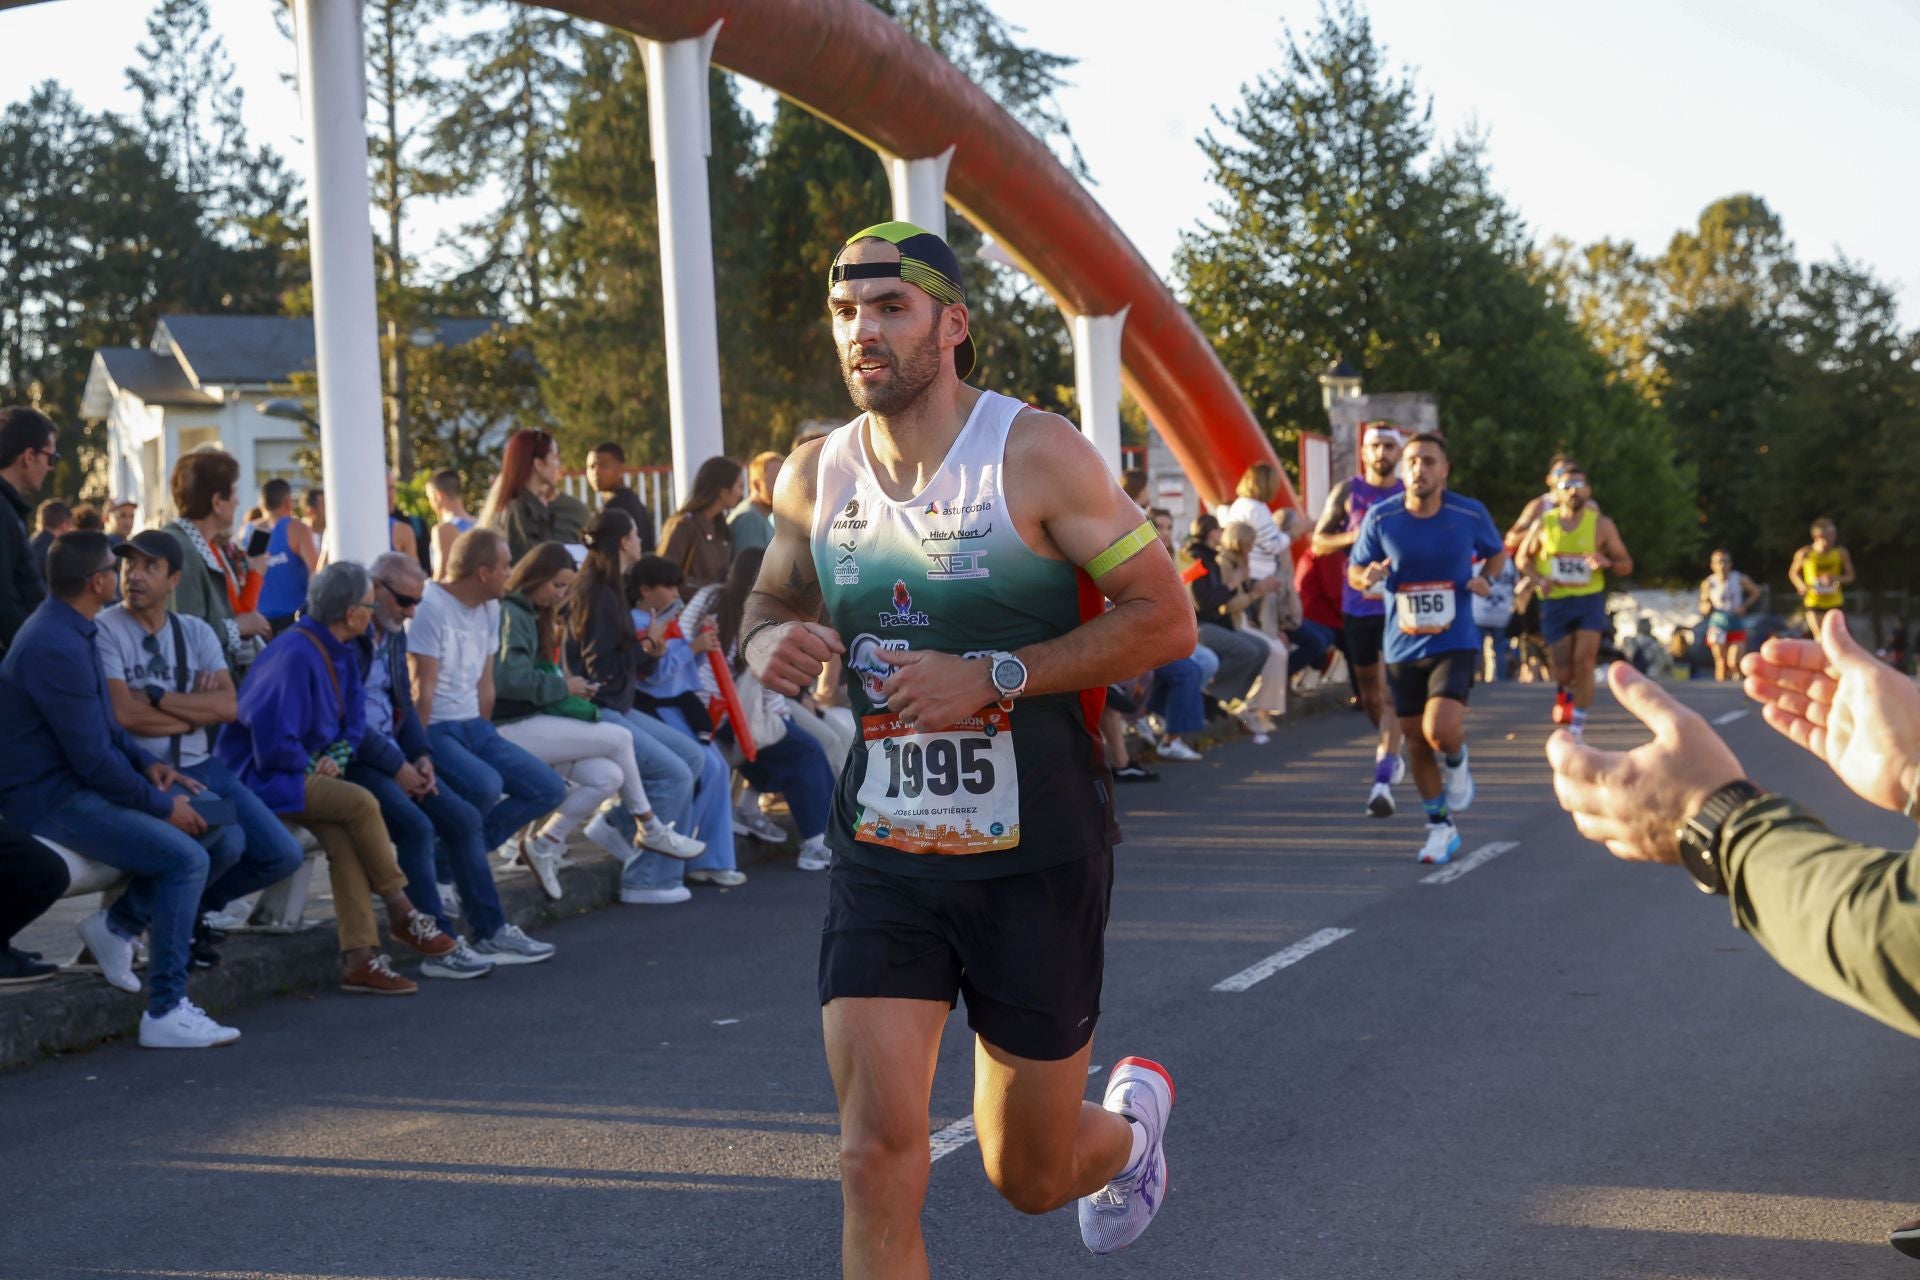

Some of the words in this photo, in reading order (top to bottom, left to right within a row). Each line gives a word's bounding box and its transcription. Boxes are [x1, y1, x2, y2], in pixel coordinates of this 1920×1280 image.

[833, 520, 868, 529] VIATOR
[1407, 594, 1444, 613] 1156
[879, 611, 929, 627] Pasek
[885, 738, 995, 799] 1995
[931, 806, 978, 815] GUTIÉRREZ
